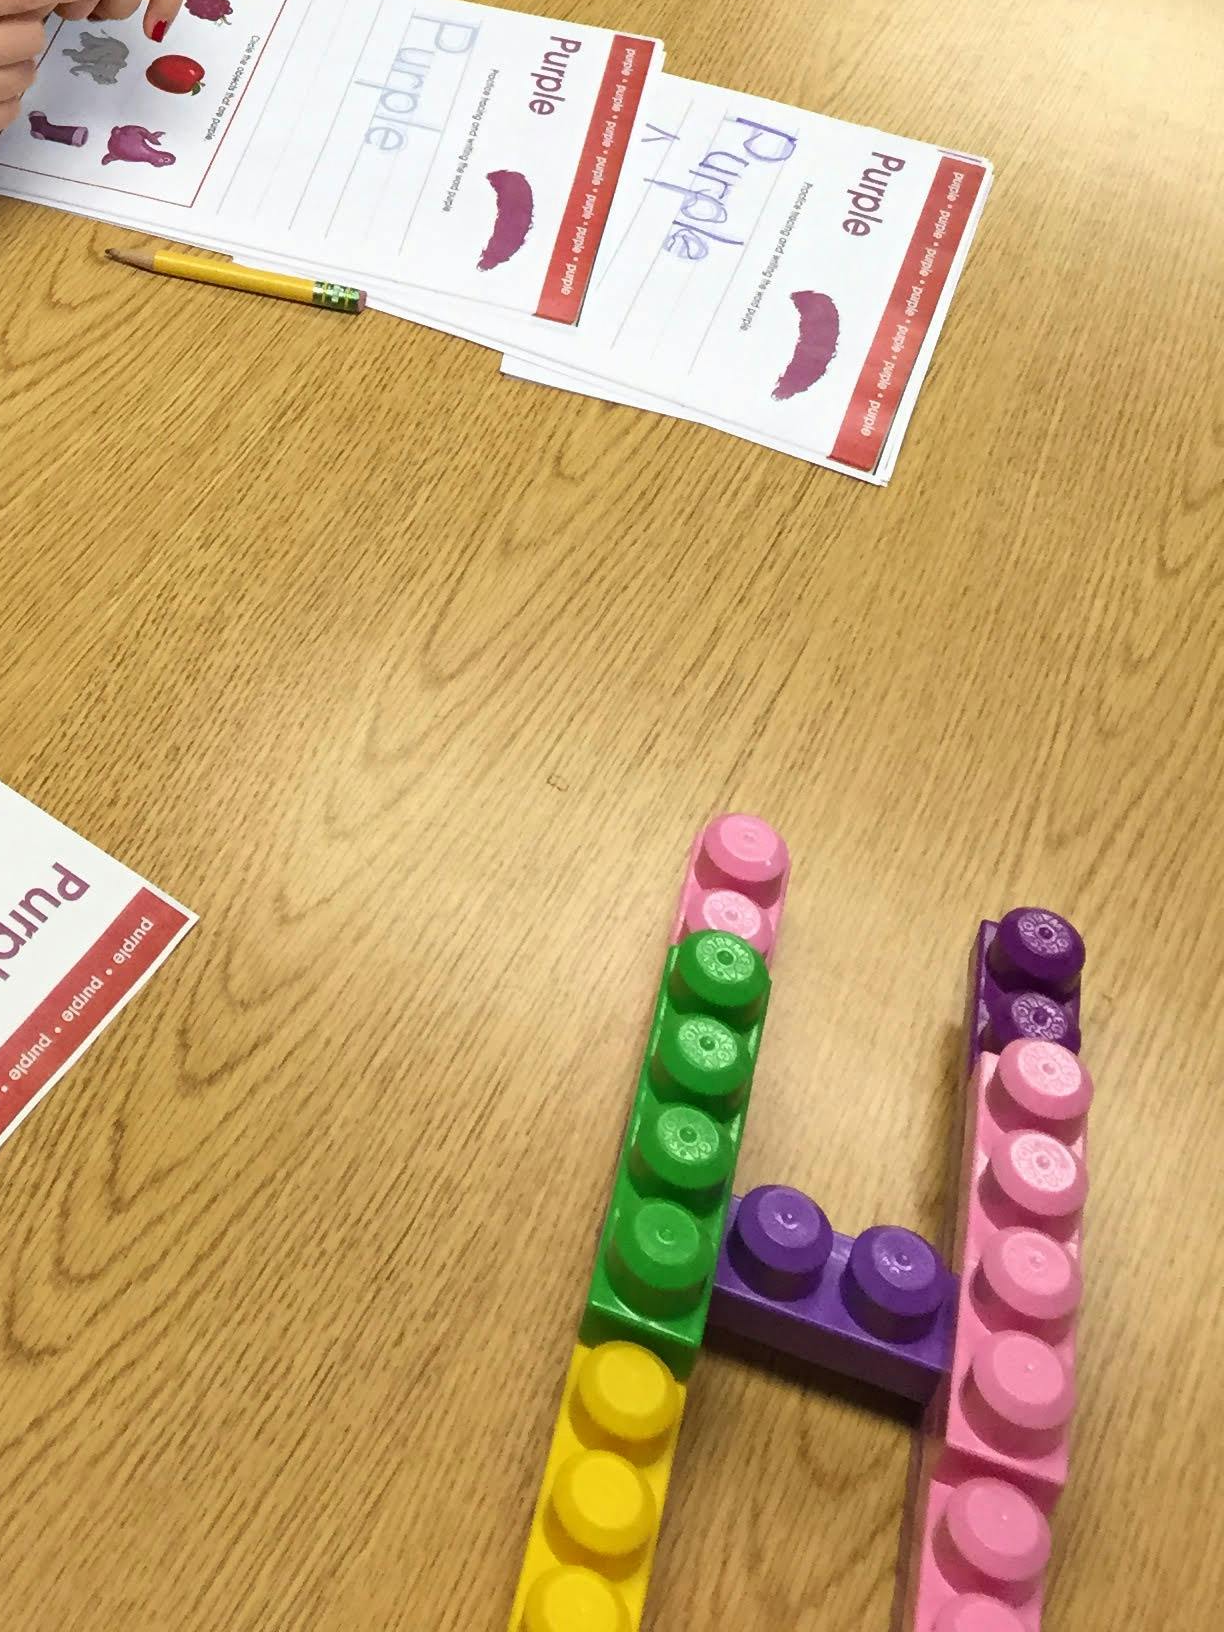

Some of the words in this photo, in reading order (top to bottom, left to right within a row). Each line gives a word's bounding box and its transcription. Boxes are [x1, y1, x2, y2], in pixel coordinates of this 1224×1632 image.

[528, 35, 582, 115] Purple
[619, 46, 636, 77] purple
[354, 15, 480, 151] Purple
[610, 82, 627, 113] purple
[600, 119, 617, 148] purple
[590, 154, 607, 186] purple
[945, 170, 965, 202] purple
[643, 117, 798, 260] Purple
[841, 151, 906, 236] Purple
[580, 192, 597, 220] purple
[570, 225, 588, 254] purple
[931, 208, 951, 239] purple
[918, 246, 937, 277] purple
[559, 261, 577, 296] purple
[903, 284, 924, 317] purple
[889, 323, 910, 354] purple
[875, 358, 896, 390] purple
[859, 398, 881, 437] purple
[111, 915, 155, 964] purple
[60, 974, 105, 1022] purple
[7, 1031, 53, 1081] purple
